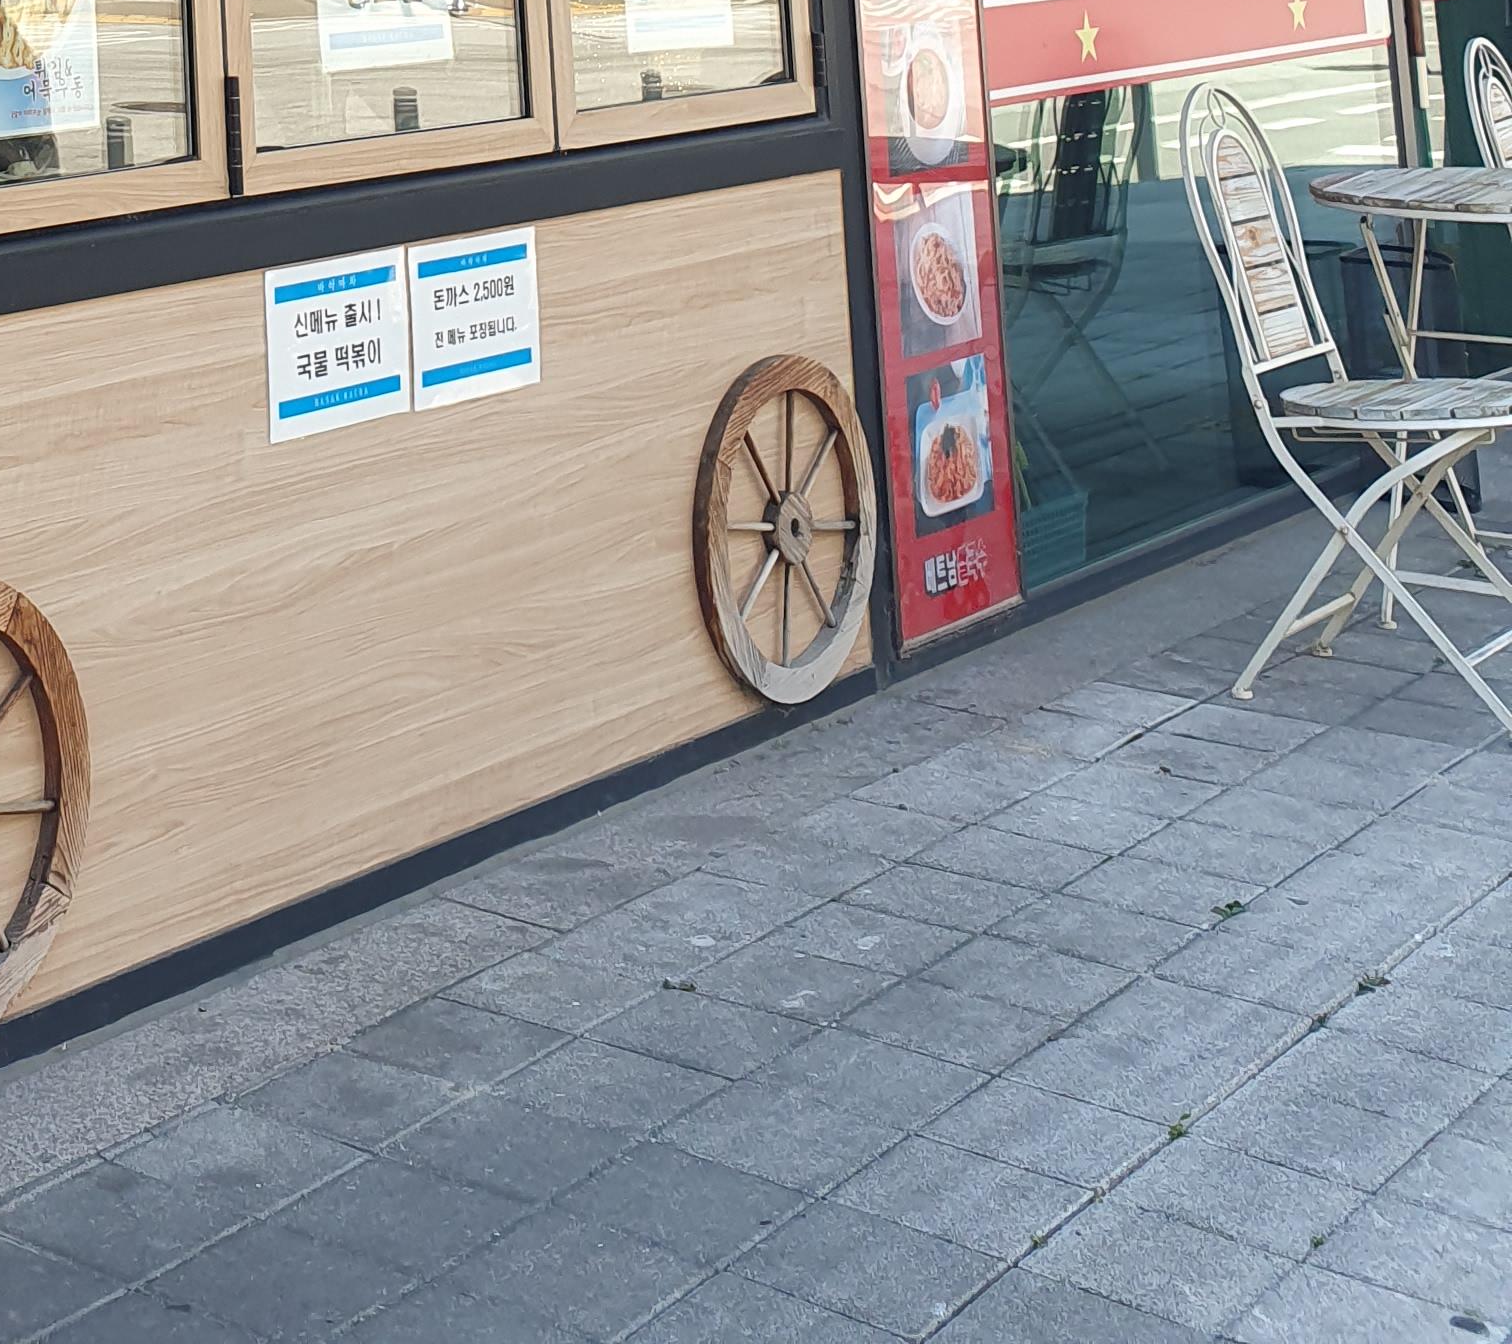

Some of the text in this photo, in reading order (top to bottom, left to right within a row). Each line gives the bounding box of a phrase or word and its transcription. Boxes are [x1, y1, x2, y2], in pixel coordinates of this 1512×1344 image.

[433, 275, 515, 311] 돈까스 2,500원
[294, 308, 338, 338] 신메뉴
[447, 327, 466, 345] 메뉴
[296, 338, 382, 381] 국물 떡볶이
